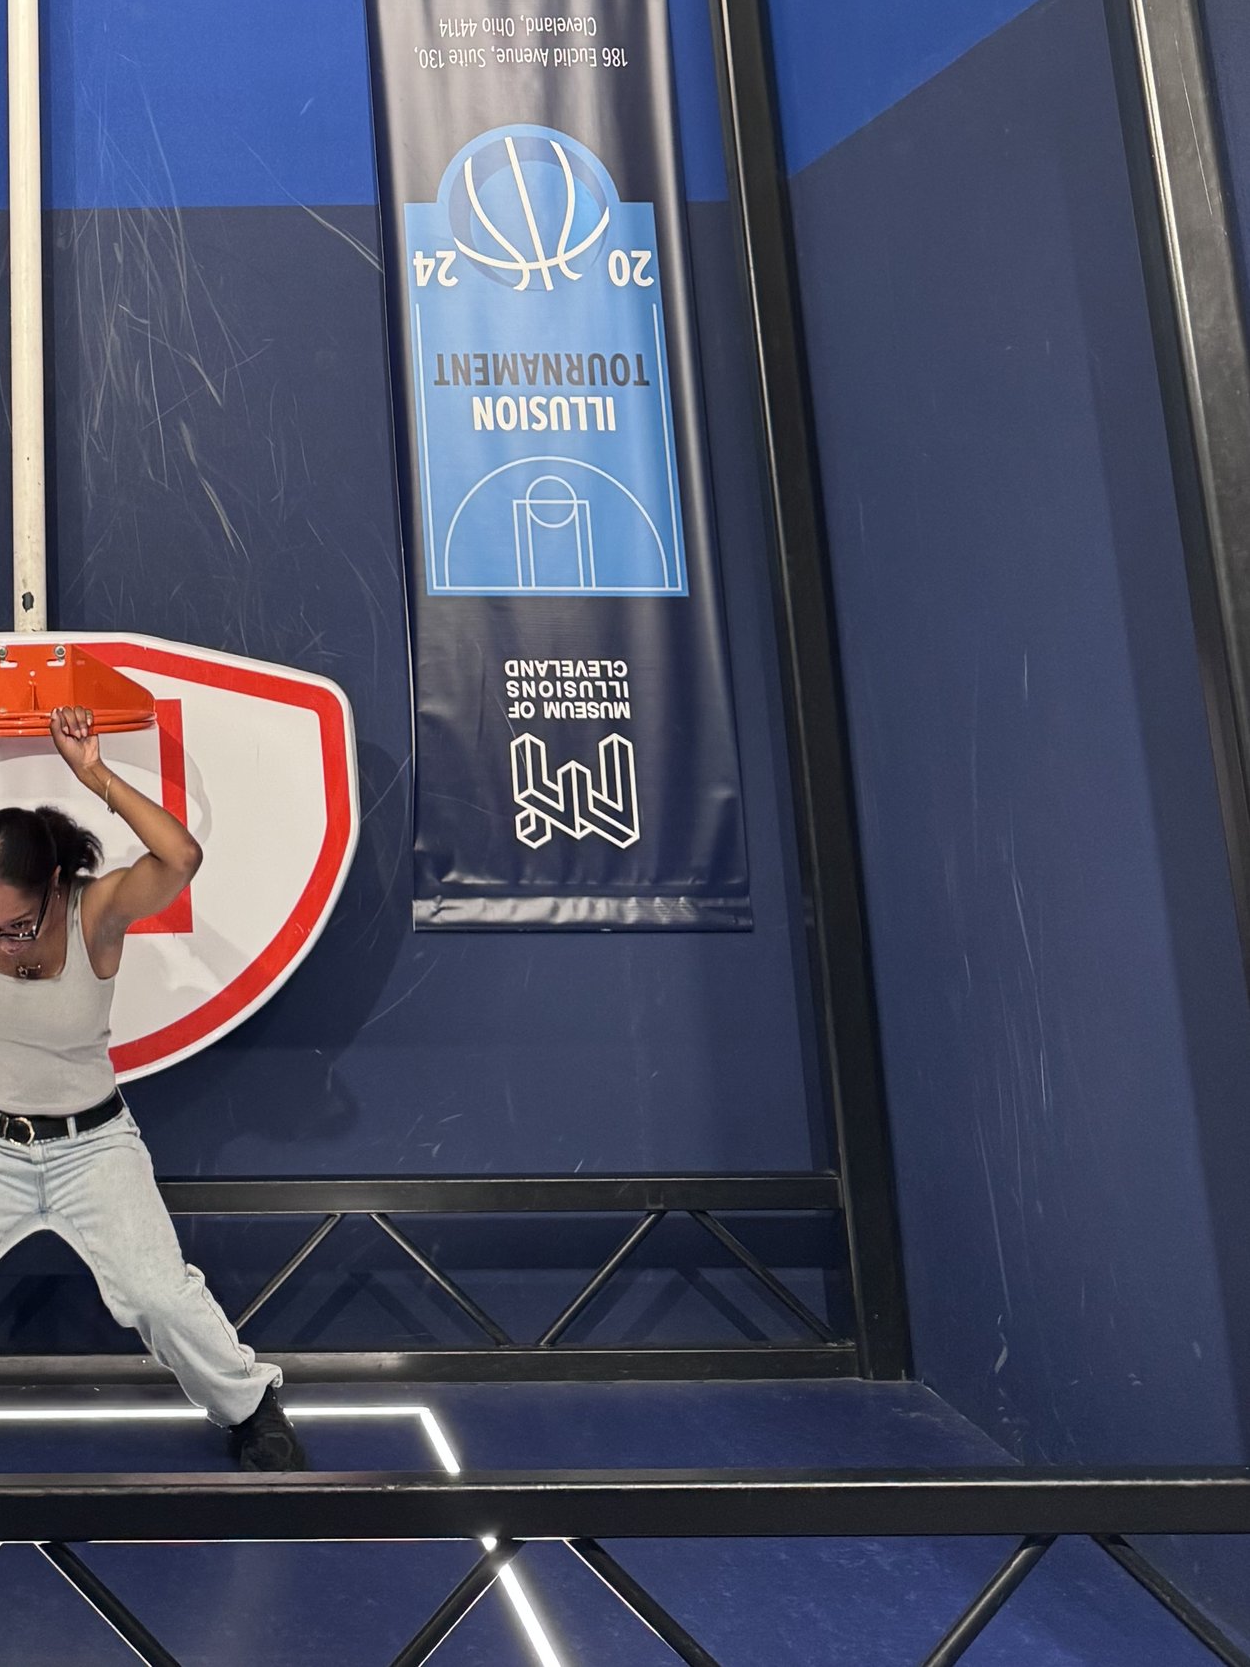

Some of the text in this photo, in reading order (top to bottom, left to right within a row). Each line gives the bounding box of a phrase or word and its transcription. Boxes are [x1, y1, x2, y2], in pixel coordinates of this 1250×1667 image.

[439, 14, 597, 38] Cleveland, Ohio 44114
[414, 45, 628, 69] 186 Euclid Avenue, Suite 130,
[413, 249, 655, 287] 20 24
[434, 352, 650, 386] TOURNAMENT
[472, 396, 616, 431] ILLUSION
[505, 660, 628, 677] CLEVELAND
[506, 681, 629, 698] ILLUSIONS
[508, 701, 631, 719] MUSEUM OF
